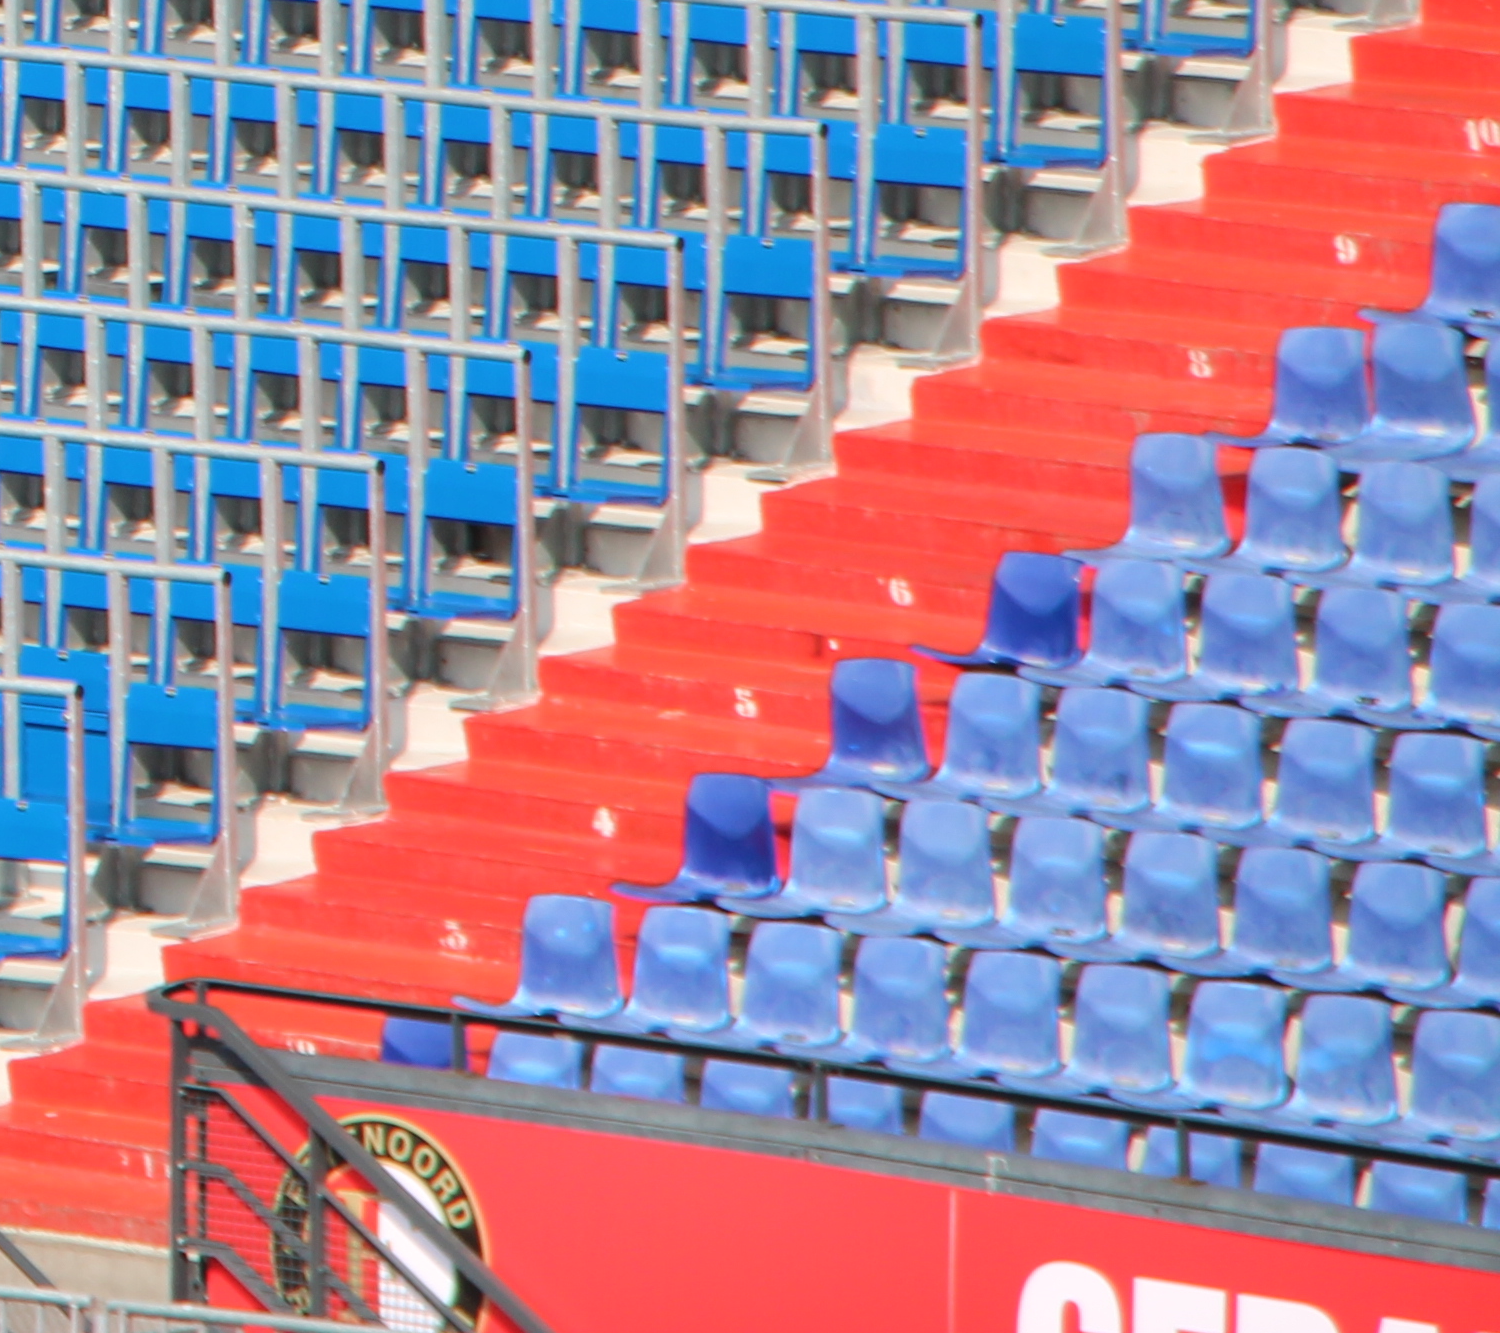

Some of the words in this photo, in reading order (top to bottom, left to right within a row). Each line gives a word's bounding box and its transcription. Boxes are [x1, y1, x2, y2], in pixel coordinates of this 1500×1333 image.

[1334, 234, 1359, 265] 9
[1189, 350, 1213, 380] 8
[888, 577, 914, 607] 6
[734, 686, 758, 719] 5
